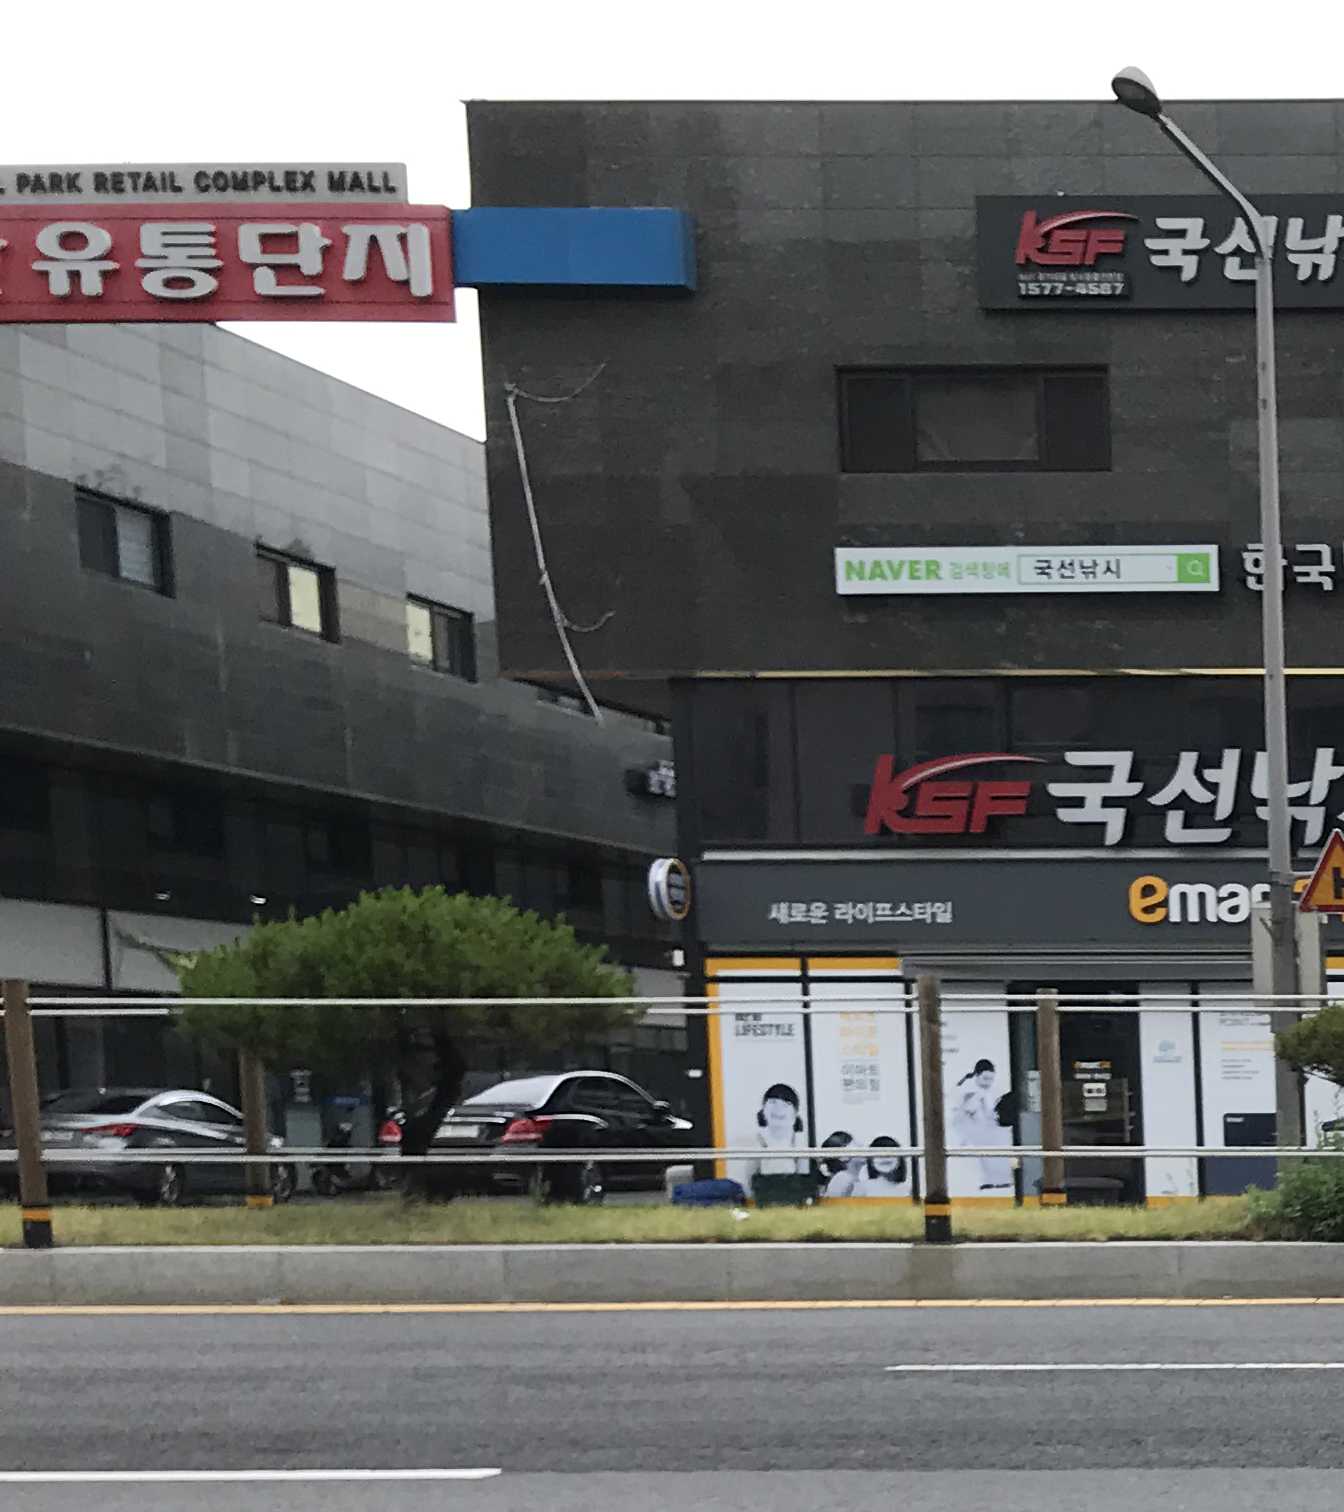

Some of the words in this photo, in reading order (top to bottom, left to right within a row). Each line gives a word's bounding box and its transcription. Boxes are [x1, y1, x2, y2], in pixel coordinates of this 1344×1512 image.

[17, 173, 82, 195] PARK
[94, 172, 183, 194] RETAIL
[195, 171, 316, 194] COMPLEX
[328, 170, 397, 193] MALL
[1015, 208, 1126, 265] KSF
[31, 221, 434, 298] 유통단지
[1018, 282, 1125, 295] 1577-4587
[844, 559, 942, 581] NAVER
[1034, 558, 1121, 580] 국선낚시
[864, 753, 1033, 835] KSF
[768, 901, 829, 924] 새로운
[833, 901, 952, 924] 라이프스타일
